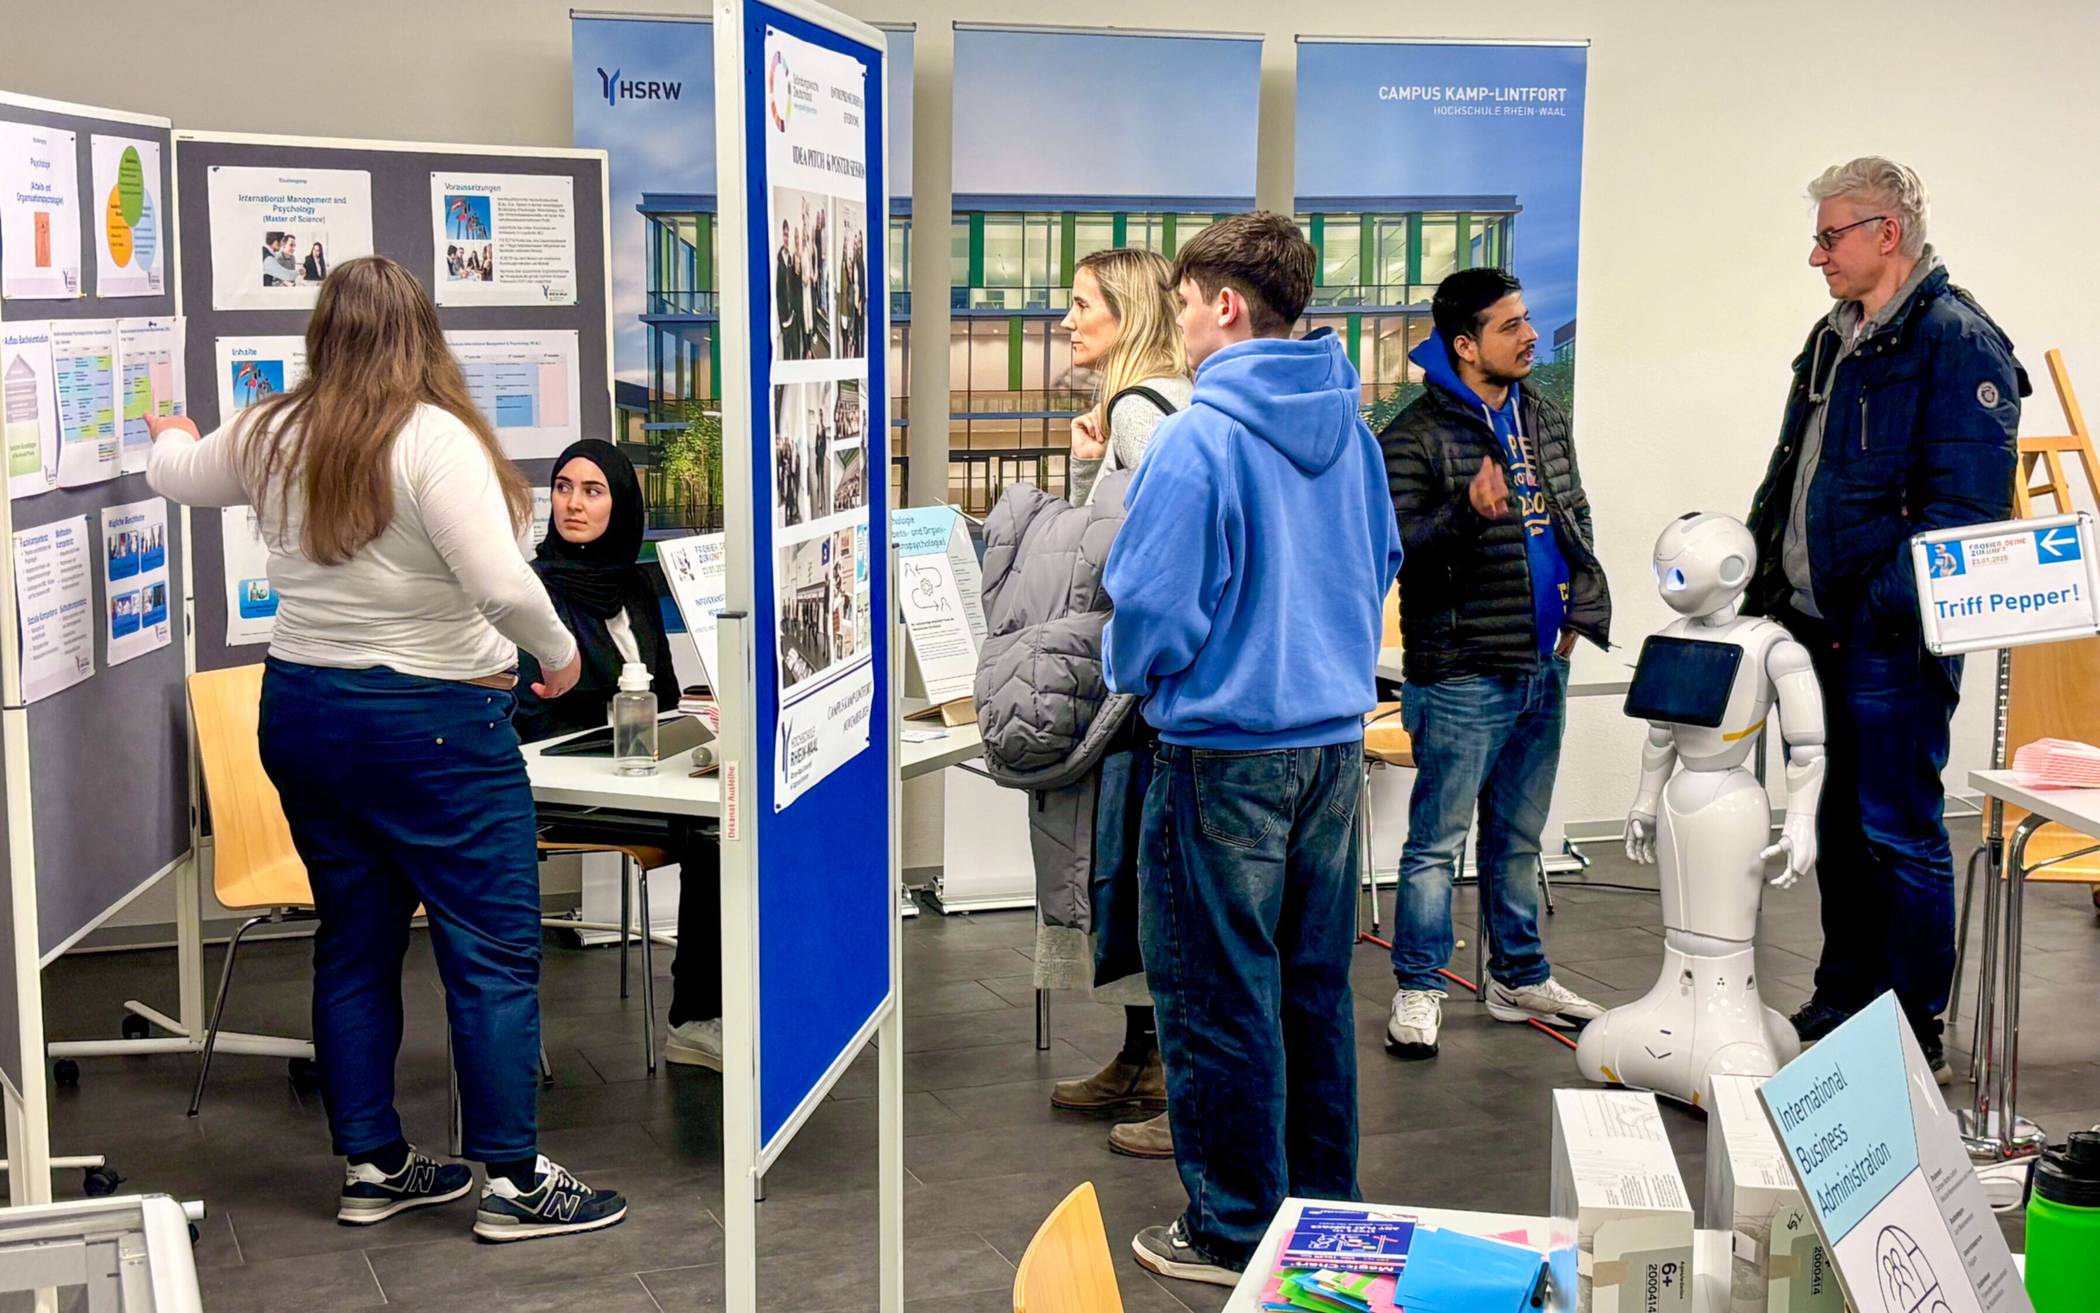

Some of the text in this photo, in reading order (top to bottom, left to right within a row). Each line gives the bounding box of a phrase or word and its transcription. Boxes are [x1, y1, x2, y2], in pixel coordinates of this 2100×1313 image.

[620, 80, 682, 100] HSRW
[1378, 86, 1568, 102] CAMPUS KAMP-LINTFORT
[1434, 106, 1500, 116] HOCHSCHULE
[444, 182, 502, 193] Voraussetzungen
[238, 194, 347, 205] International Management and
[273, 205, 316, 215] Psychology
[263, 215, 288, 223] (Master
[298, 215, 326, 224] Science)
[1934, 583, 2079, 619] Triff Pepper!
[1776, 1062, 1848, 1133] International
[1796, 1122, 1849, 1176] Business
[1816, 1142, 1892, 1218] Administration
[1662, 1262, 1677, 1287] 6+
